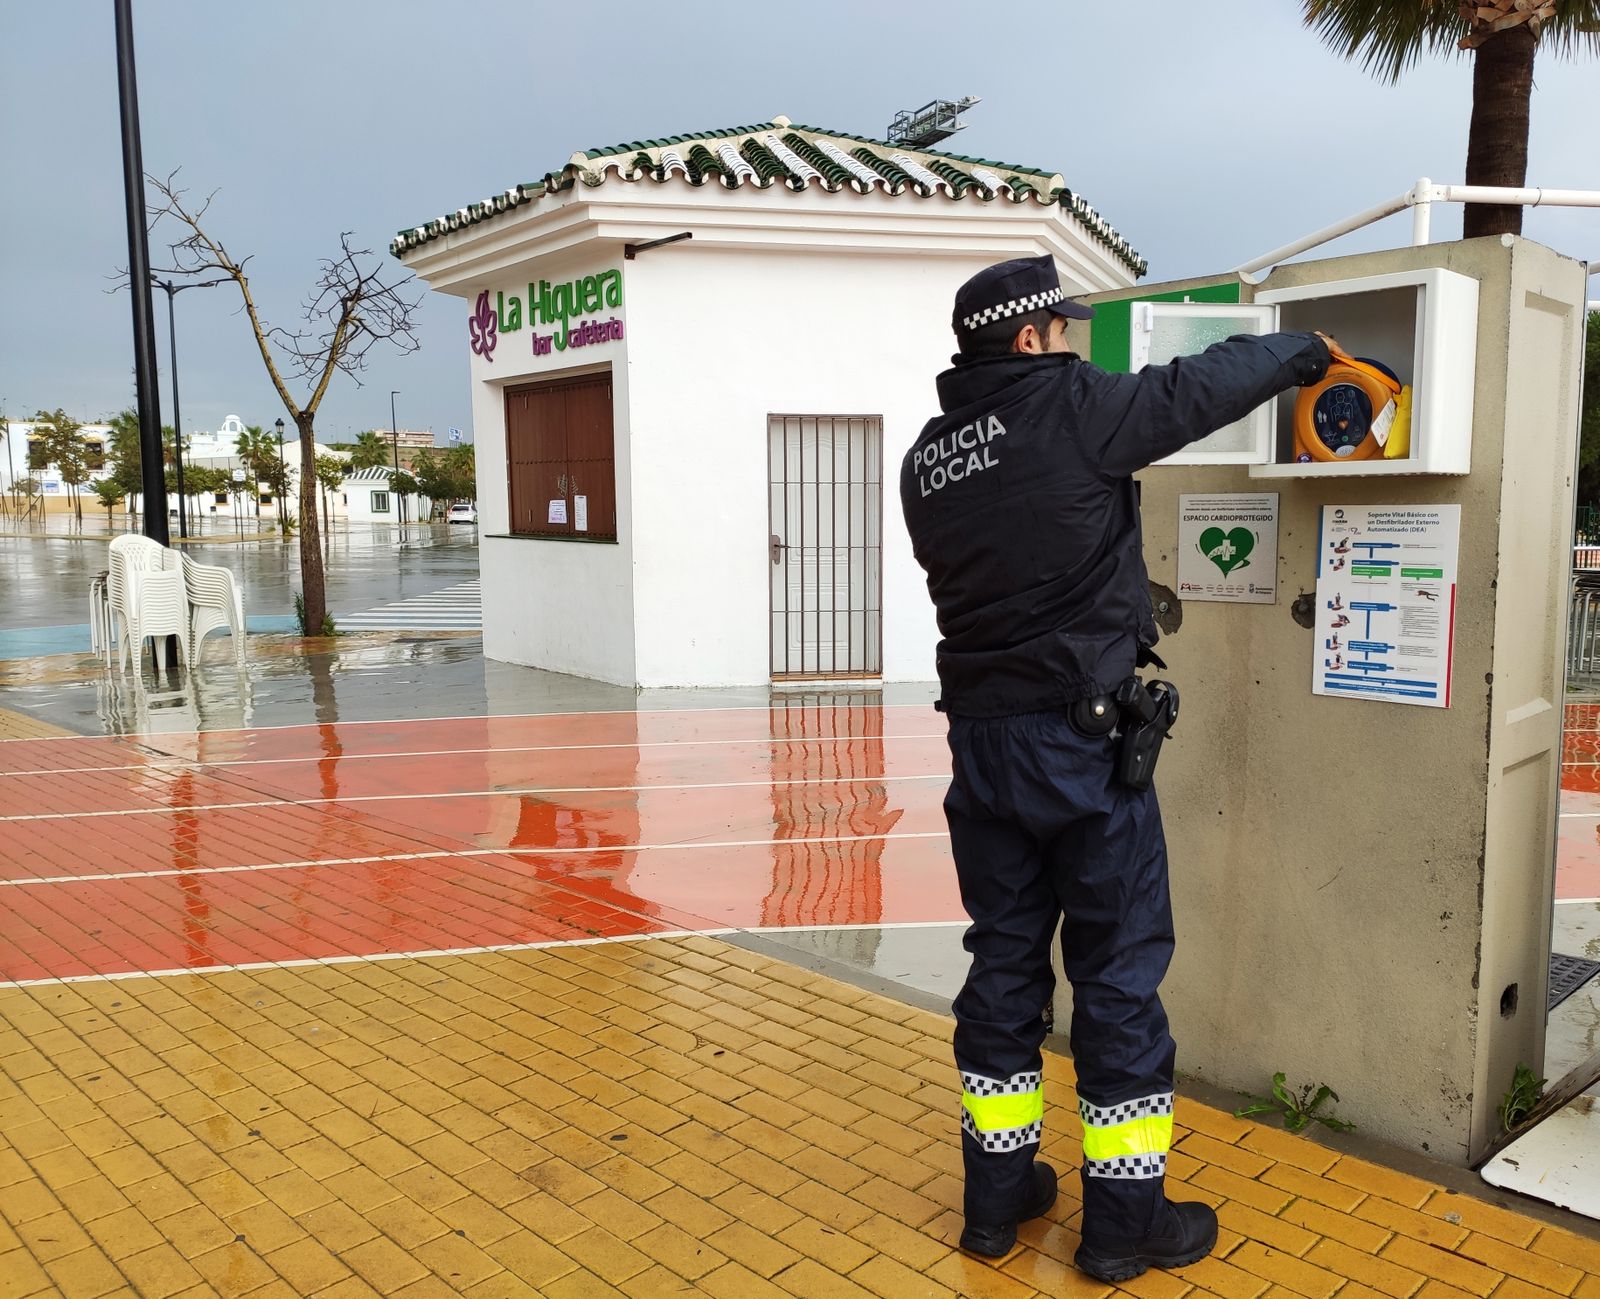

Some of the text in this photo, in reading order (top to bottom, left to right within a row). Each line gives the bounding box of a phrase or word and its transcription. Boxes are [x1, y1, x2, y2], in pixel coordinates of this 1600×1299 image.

[497, 268, 622, 351] La Higuera
[532, 332, 553, 355] bar
[913, 415, 1007, 474] POLICIA
[920, 446, 1000, 498] LOCAL
